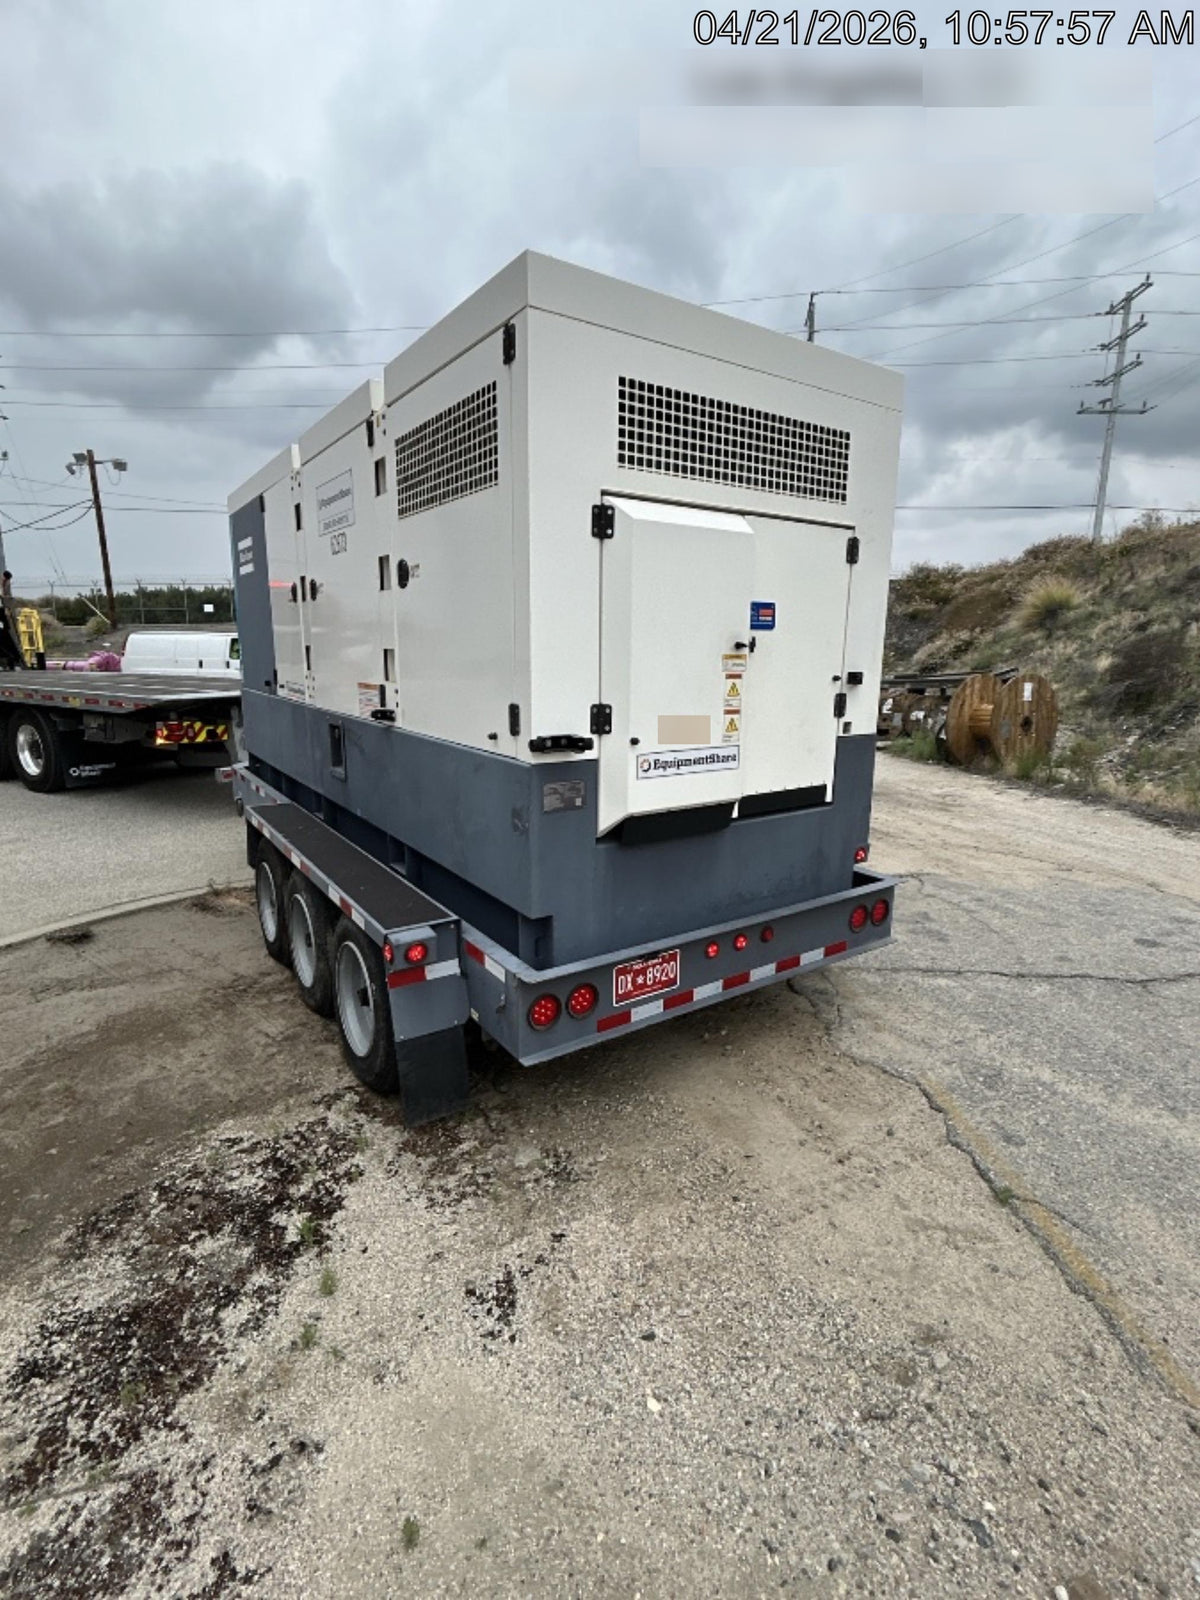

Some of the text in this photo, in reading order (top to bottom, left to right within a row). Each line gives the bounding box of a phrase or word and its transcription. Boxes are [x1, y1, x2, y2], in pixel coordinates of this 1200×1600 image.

[653, 753, 738, 771] EquipmentShare
[618, 972, 634, 994] DX
[646, 961, 677, 986] 8920
